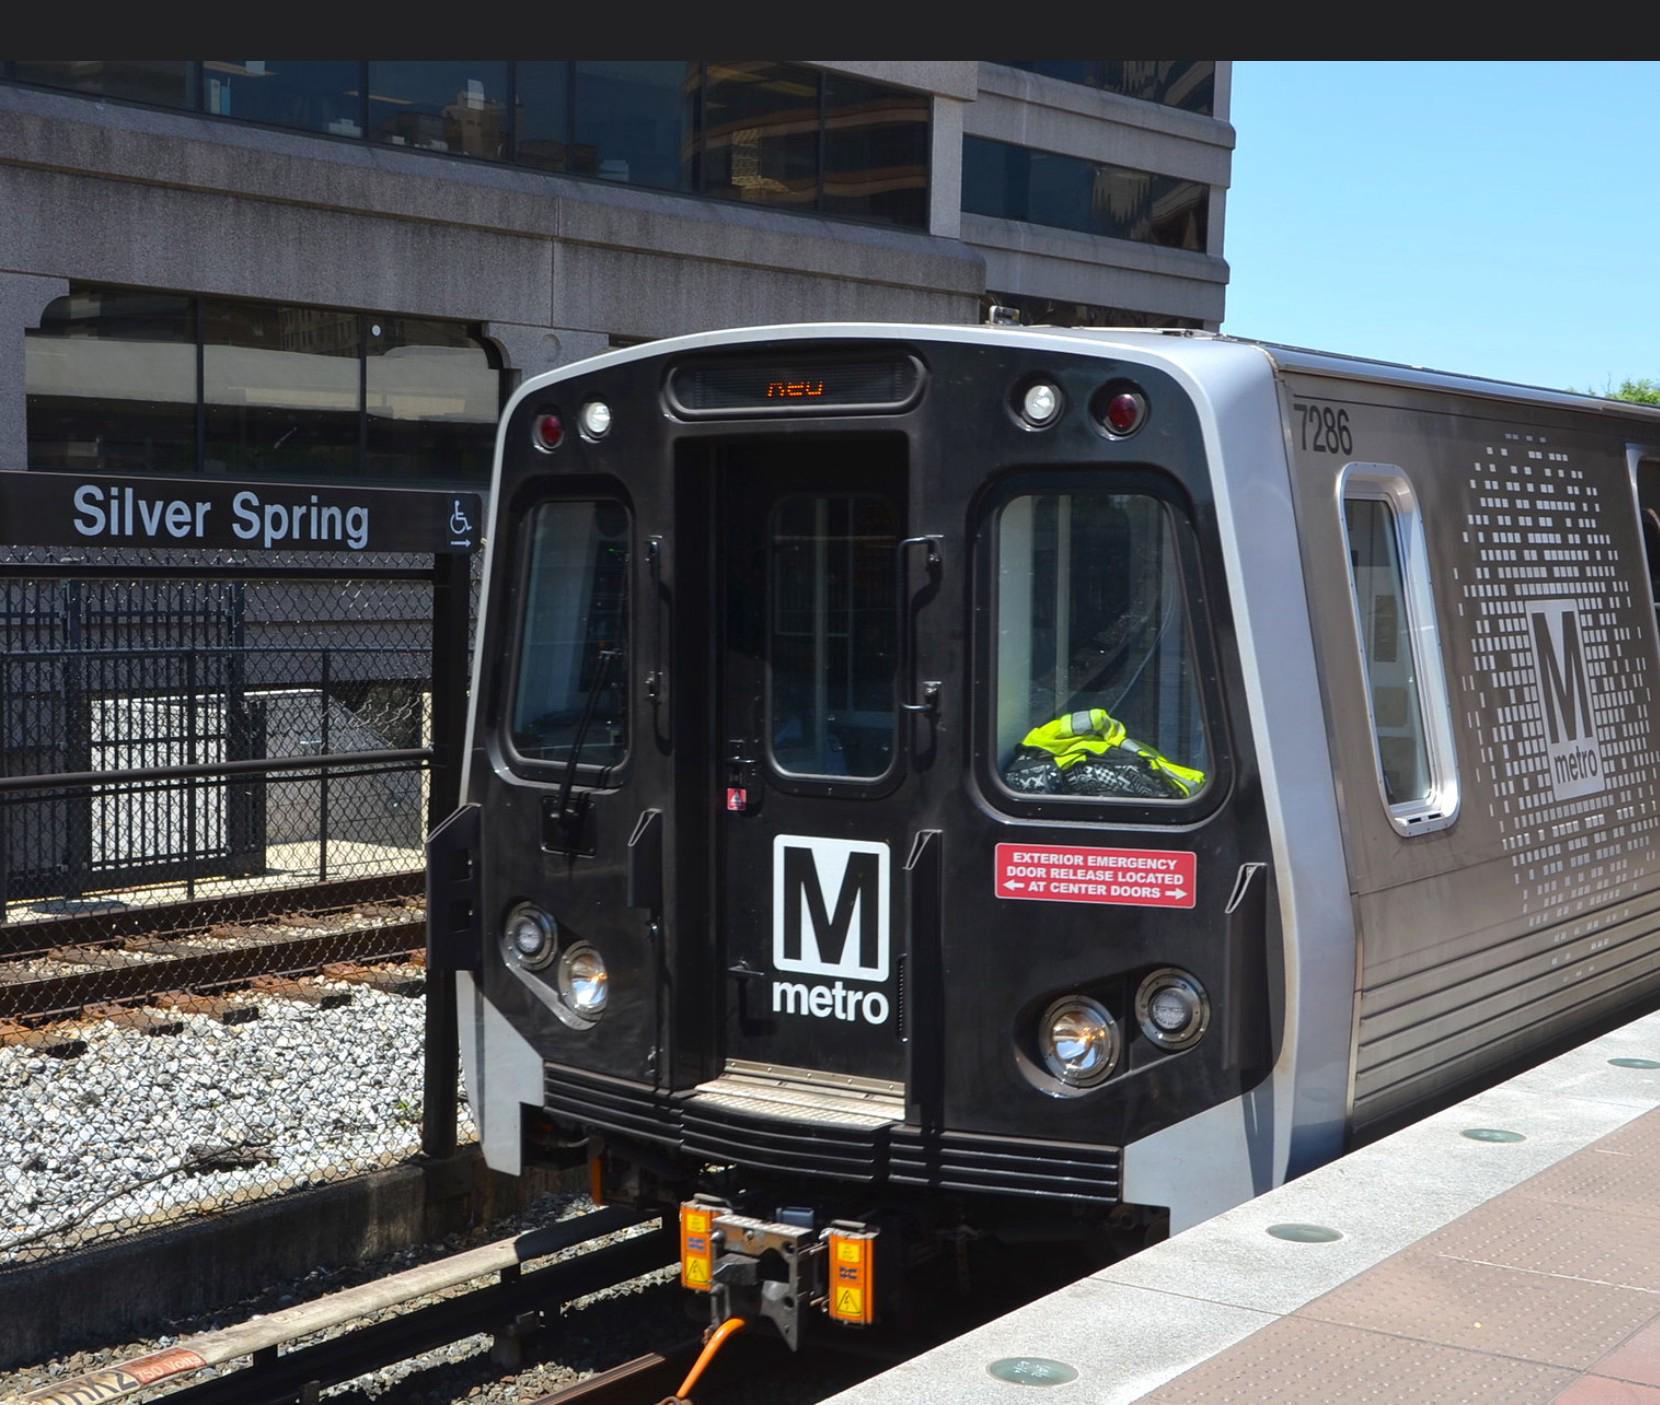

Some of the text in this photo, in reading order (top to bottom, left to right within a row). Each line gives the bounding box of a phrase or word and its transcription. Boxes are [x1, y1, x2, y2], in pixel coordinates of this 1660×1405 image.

[1294, 404, 1353, 455] 7286
[73, 484, 370, 550] Silver Spring
[1531, 611, 1594, 744] M
[1554, 745, 1600, 785] metro
[1006, 866, 1184, 885] DOOR RELEASE LOCATED
[1013, 852, 1178, 870] EXTERIOR EMERGENCY
[783, 846, 880, 969] M
[1028, 881, 1161, 898] AT CENTER DOORS
[772, 981, 889, 1025] metro
